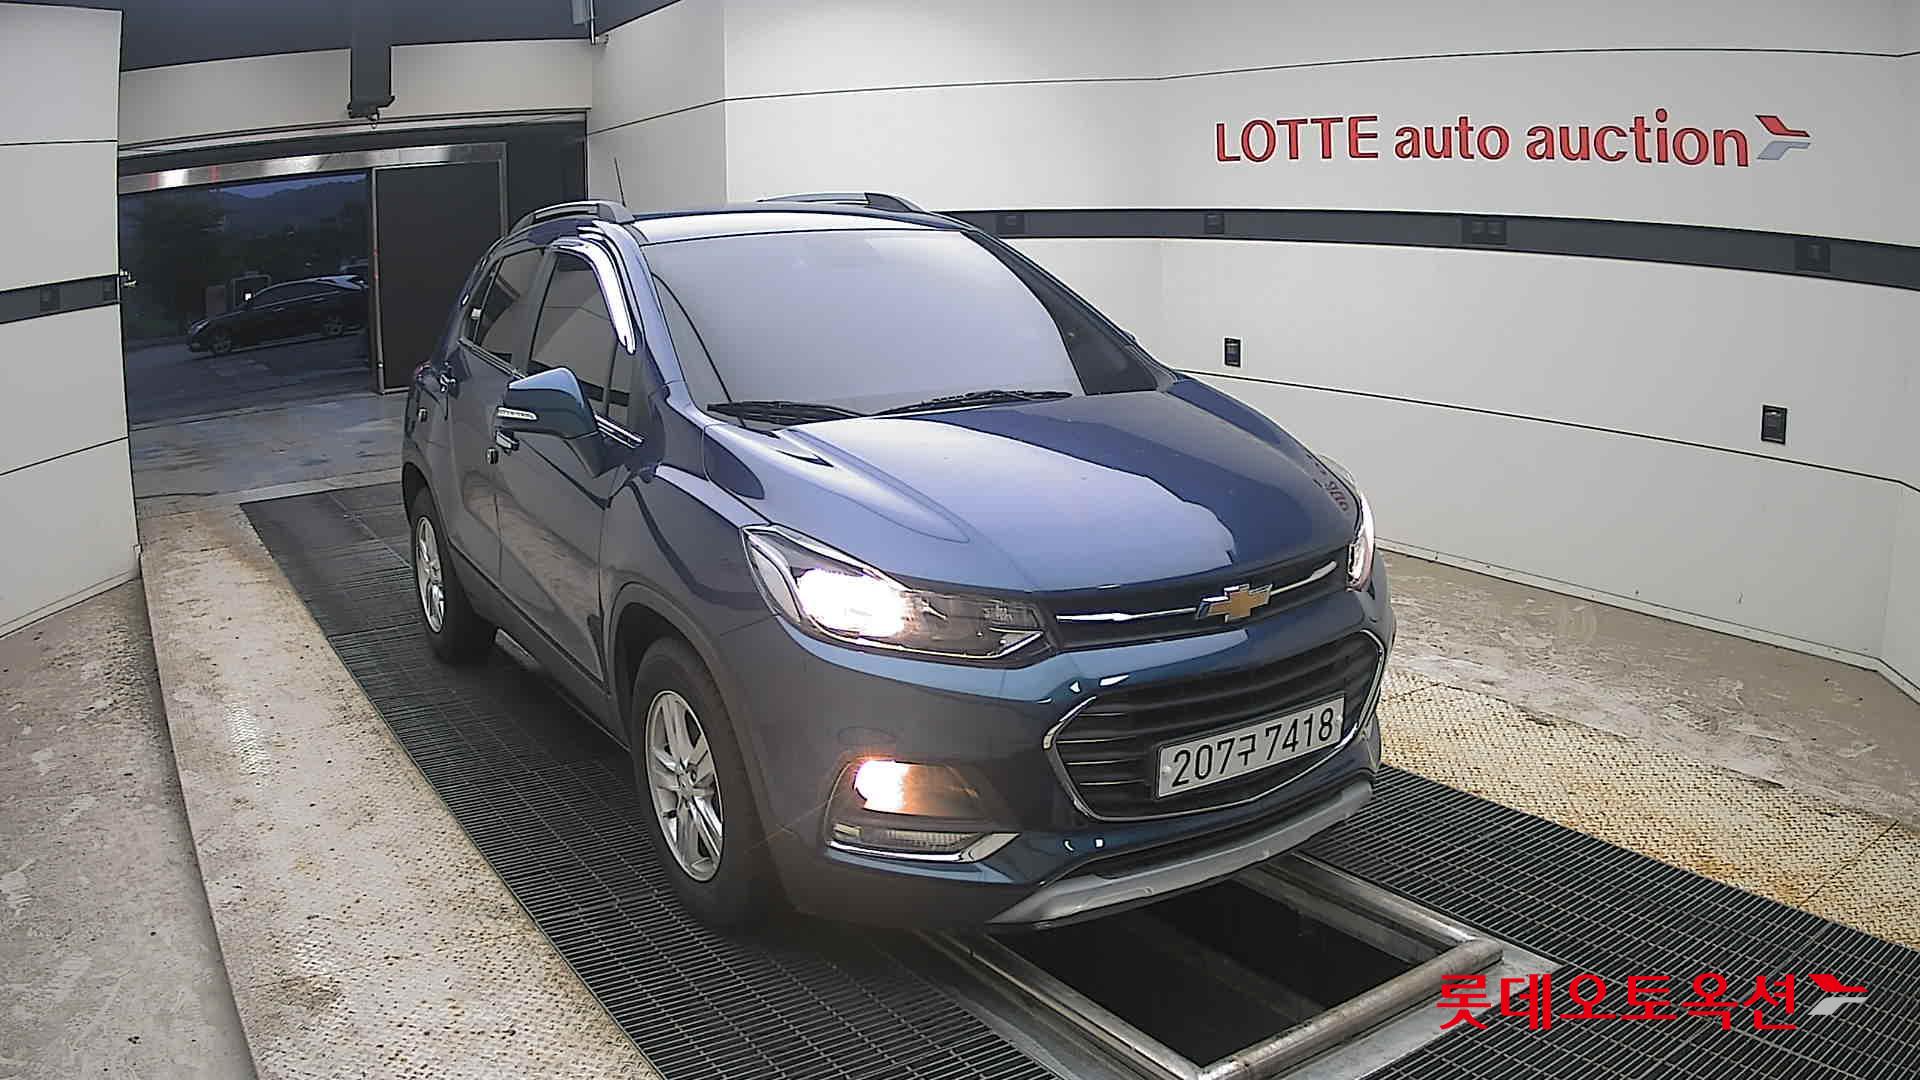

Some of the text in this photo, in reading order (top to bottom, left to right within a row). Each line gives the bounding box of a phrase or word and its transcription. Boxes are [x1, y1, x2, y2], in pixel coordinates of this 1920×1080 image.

[1215, 107, 1750, 168] LOTTE auto auction
